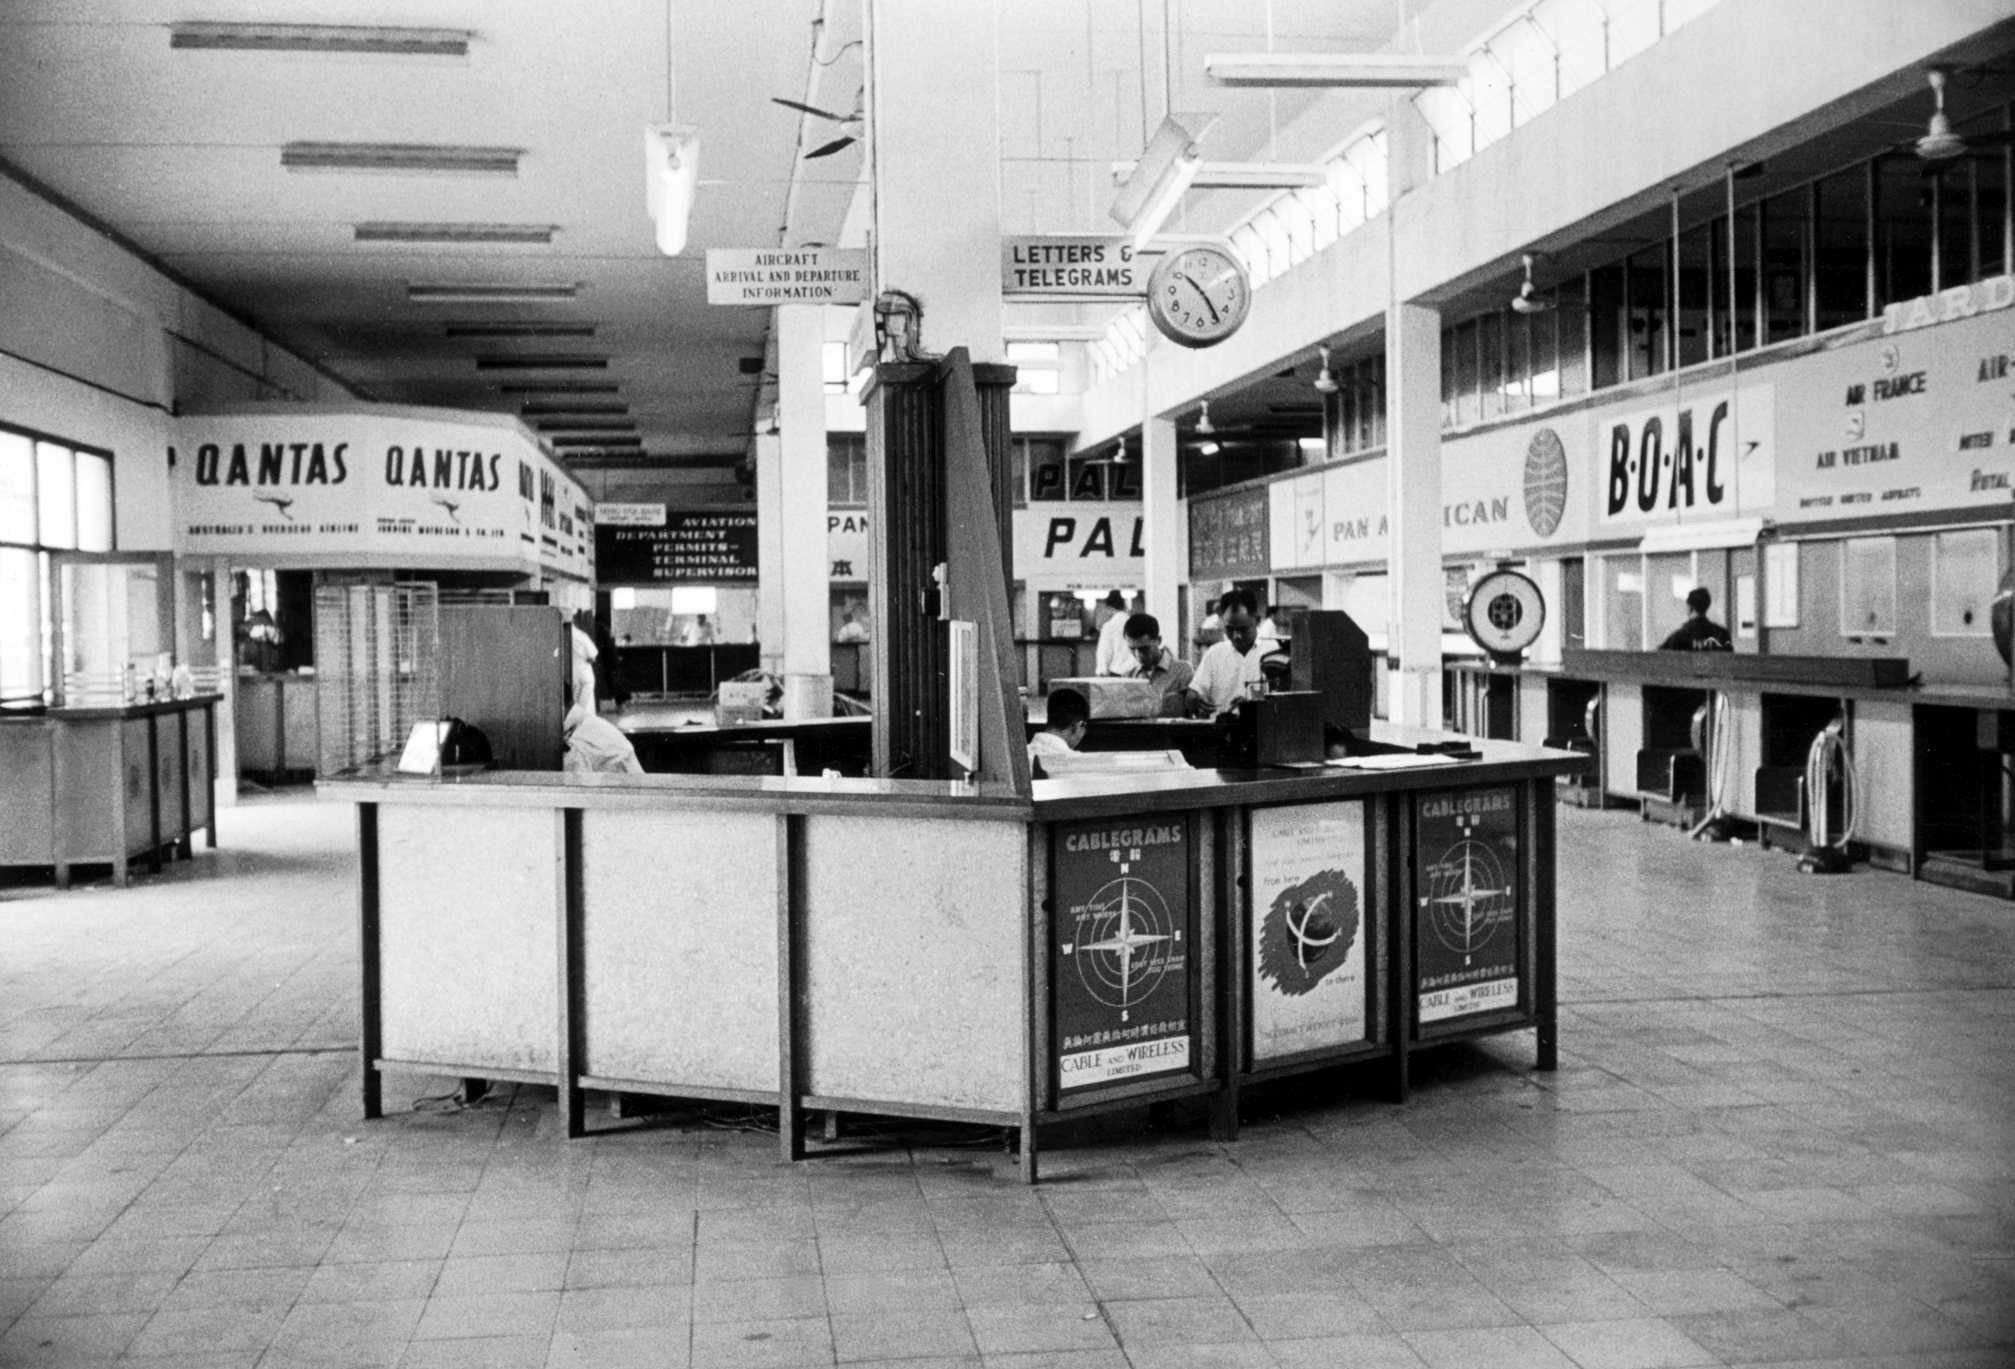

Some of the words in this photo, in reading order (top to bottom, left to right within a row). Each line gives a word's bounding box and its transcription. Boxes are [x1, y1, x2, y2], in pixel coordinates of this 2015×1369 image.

[755, 253, 819, 266] AIRCRAFT
[1013, 244, 1106, 264] LETTERS
[1120, 244, 1133, 263] &
[714, 271, 765, 283] ARRIVAL
[769, 271, 791, 282] AND
[794, 270, 862, 282] DEPARTURE
[1013, 268, 1133, 287] TELEGRAMS
[743, 286, 834, 298] INFORMATION
[1845, 383, 1866, 407] AIR
[1872, 370, 1927, 402] FRANCE
[195, 442, 348, 487] QANTAS
[385, 445, 502, 492] QANTAS
[1032, 462, 1140, 499] PAL
[682, 517, 758, 528] AVIATION
[1333, 517, 1369, 542] PAN
[615, 530, 728, 541] DEPARTMENT
[1043, 516, 1145, 559] PAL
[653, 554, 740, 565] TERMINAL
[652, 566, 758, 577] SUPERVISOR
[1422, 794, 1511, 818] CABLEGRAMS
[1065, 825, 1182, 852] CABLEGRAMS
[1060, 1052, 1103, 1074] CABLE
[1126, 1039, 1187, 1062] WIRELESS
